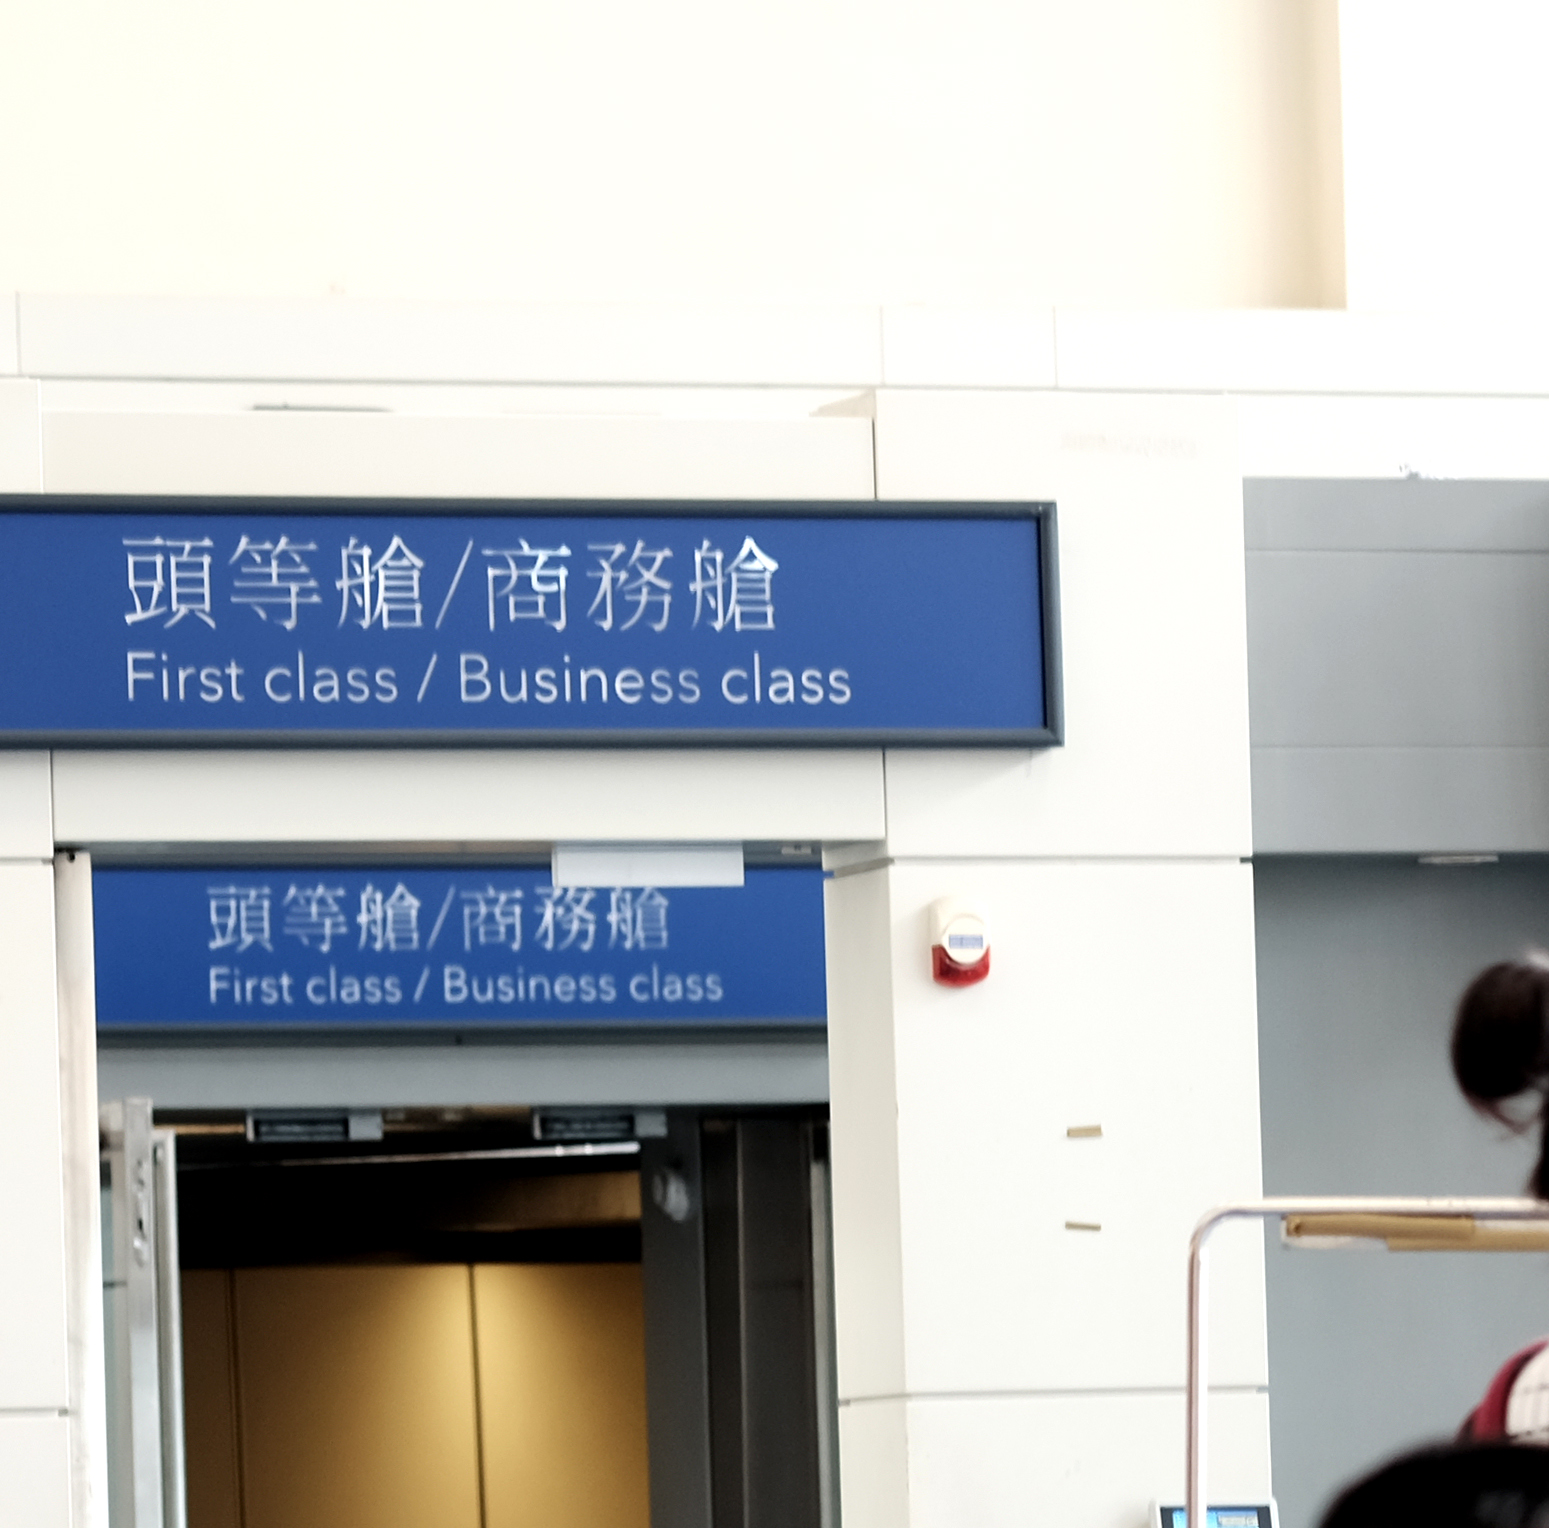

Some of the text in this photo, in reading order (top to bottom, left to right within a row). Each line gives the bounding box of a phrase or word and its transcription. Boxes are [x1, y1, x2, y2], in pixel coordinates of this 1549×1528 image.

[127, 651, 244, 702] First
[264, 651, 398, 702] class
[459, 653, 700, 704] Business
[721, 651, 851, 704] class
[208, 965, 293, 1005] First
[305, 964, 402, 1004] class
[443, 965, 616, 1003] Business
[629, 963, 723, 1002] class
